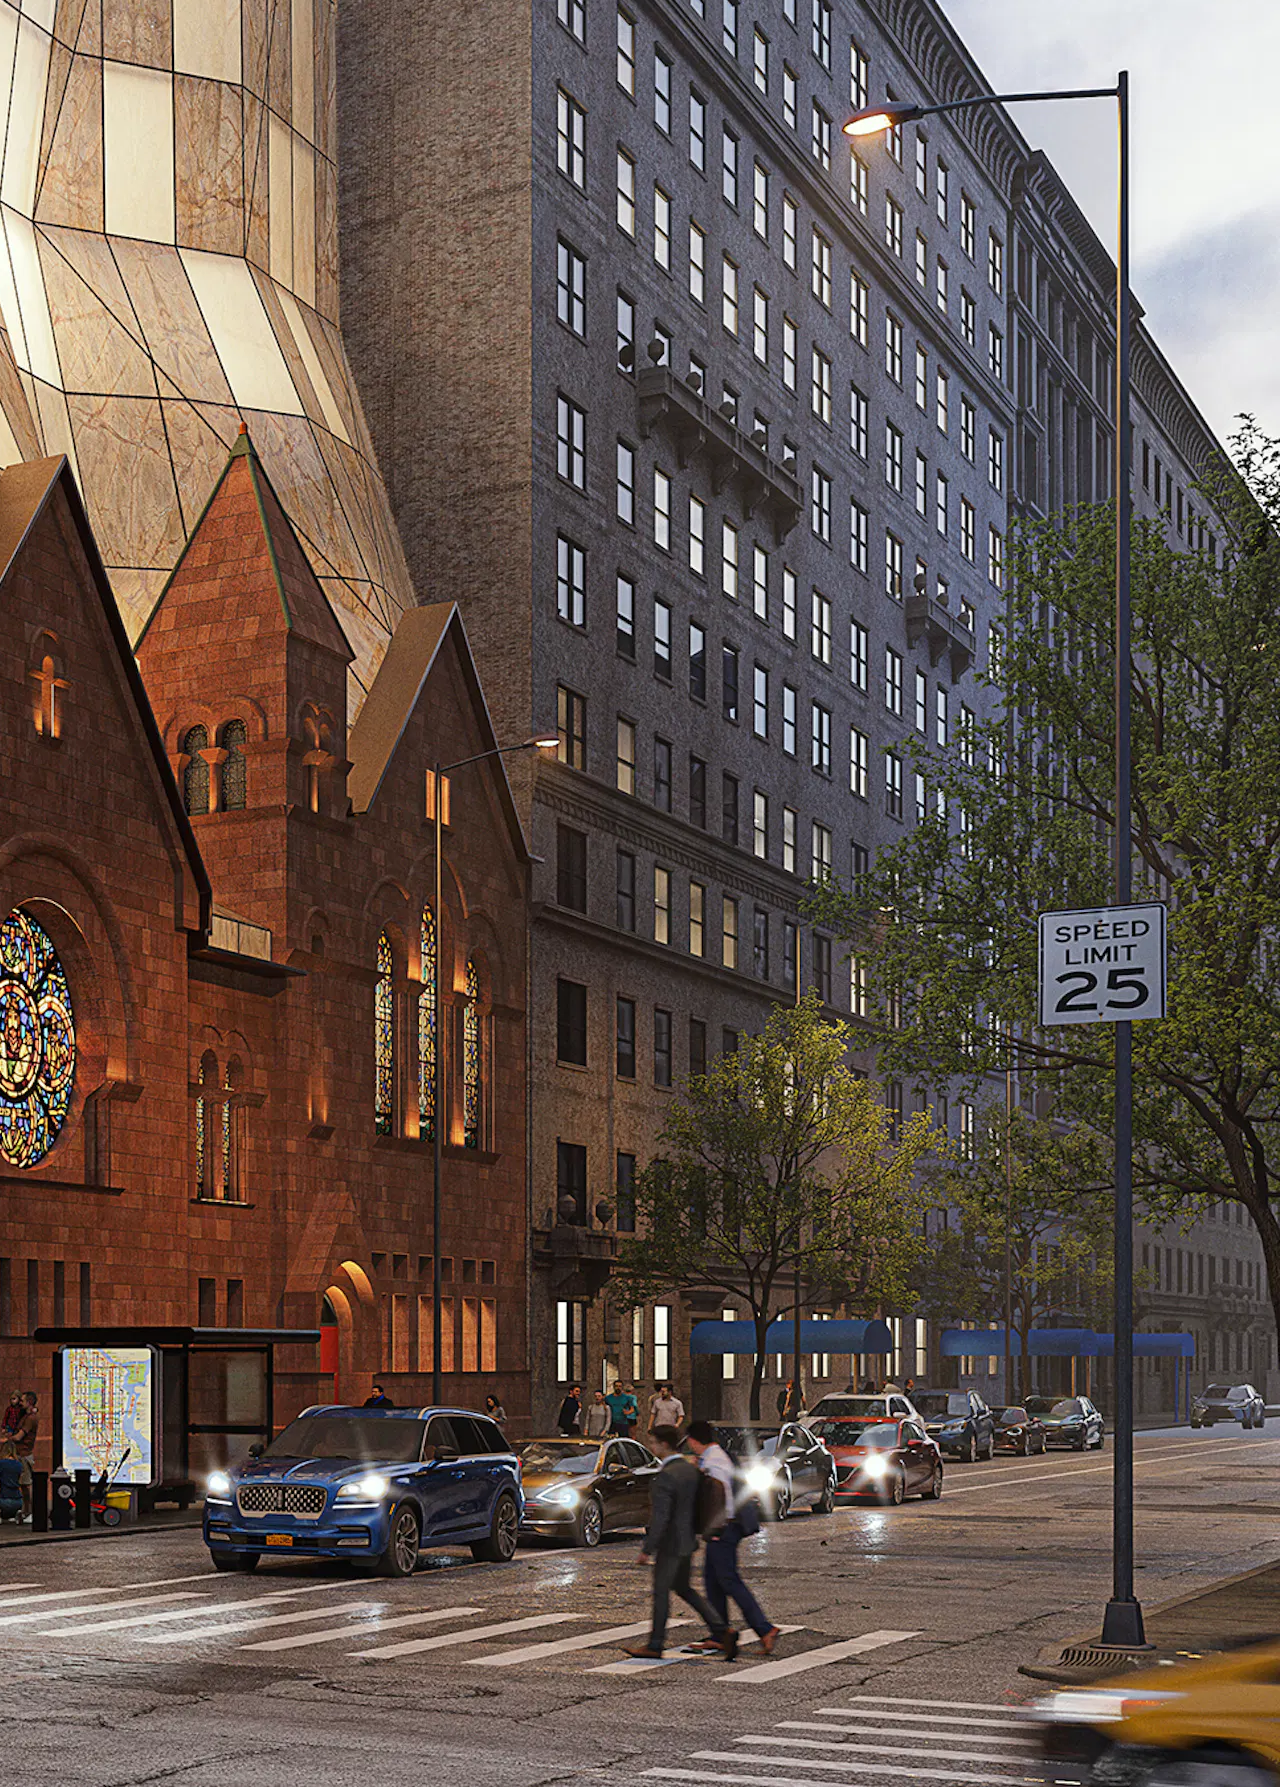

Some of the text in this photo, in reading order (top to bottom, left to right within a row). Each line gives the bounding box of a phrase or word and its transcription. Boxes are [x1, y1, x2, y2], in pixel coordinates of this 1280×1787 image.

[1055, 919, 1150, 943] SPEED
[1065, 944, 1138, 966] LIMIT
[1054, 967, 1150, 1013] 25
